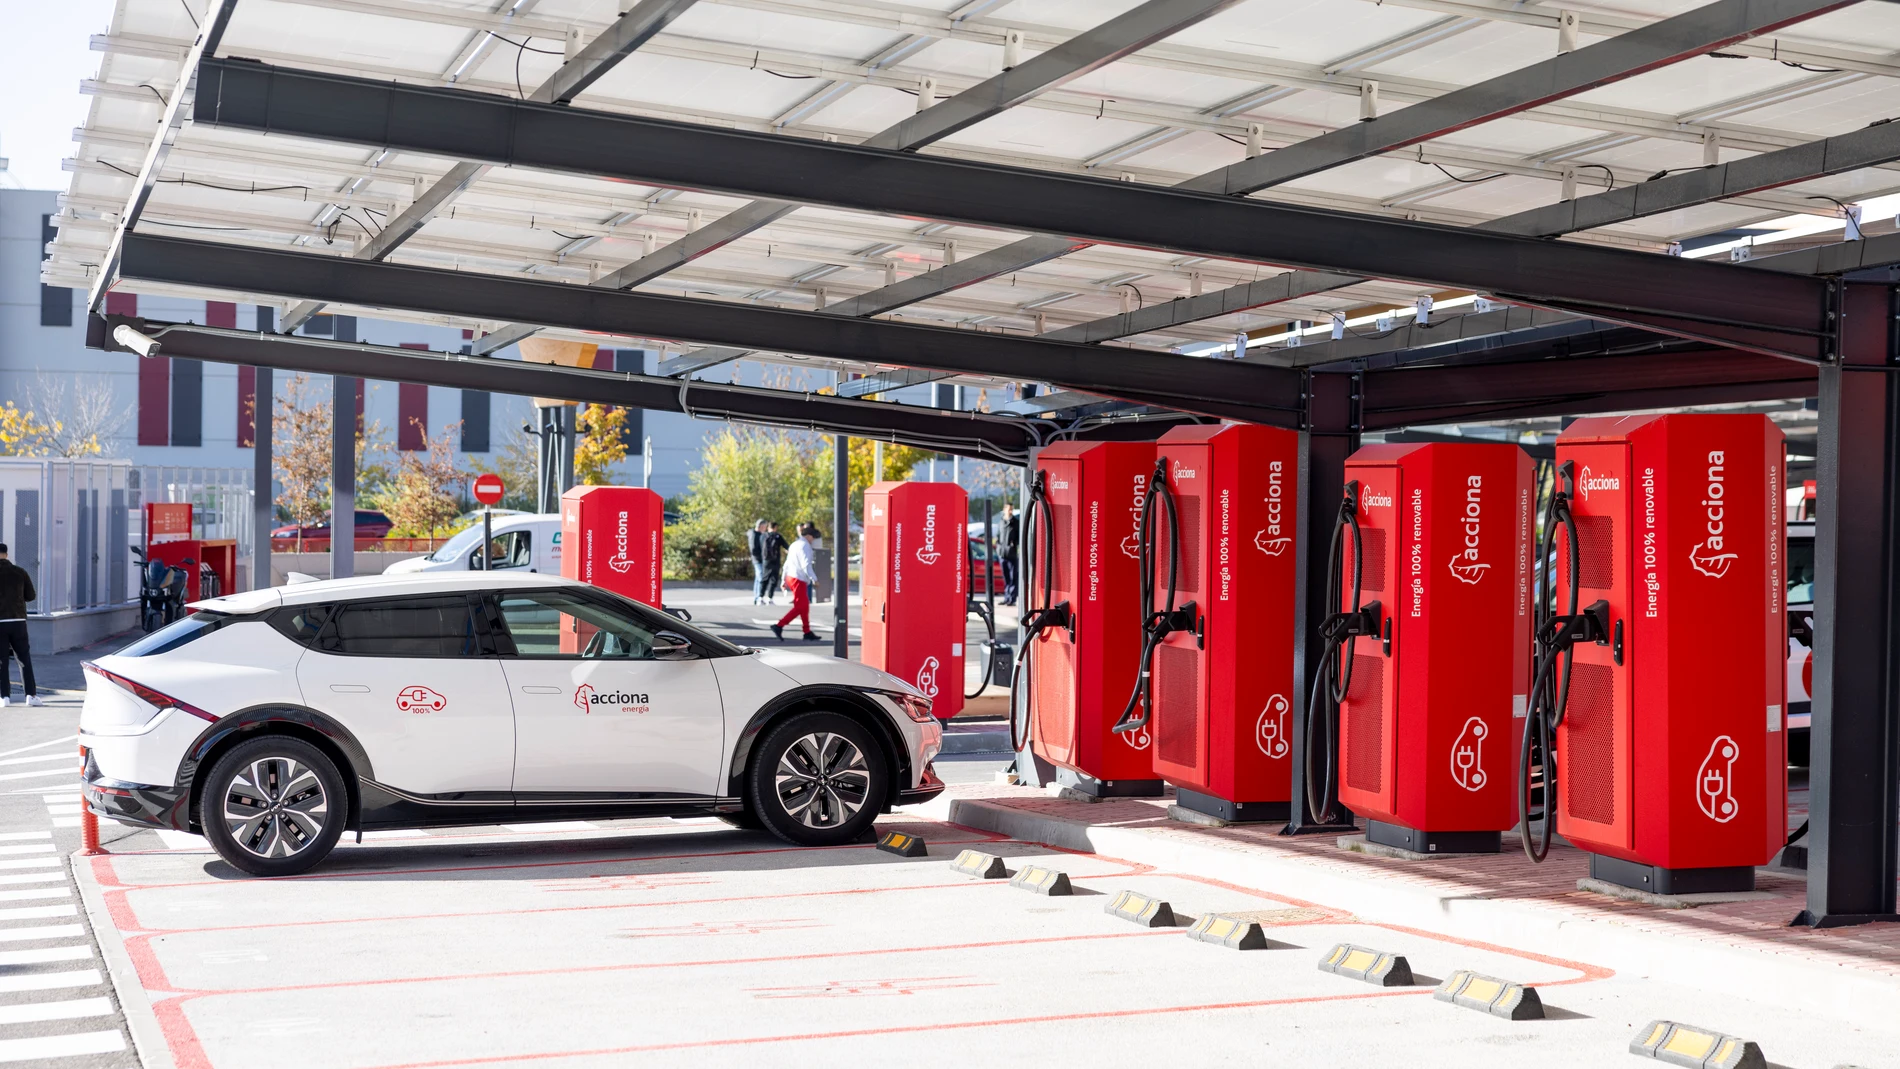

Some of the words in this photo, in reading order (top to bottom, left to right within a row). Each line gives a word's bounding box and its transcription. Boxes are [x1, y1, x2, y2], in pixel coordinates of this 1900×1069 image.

[1178, 466, 1195, 478] acciona
[1588, 474, 1620, 490] acciona
[1129, 475, 1145, 540] acciona
[1220, 489, 1229, 534] renovable
[1264, 461, 1282, 535] acciona
[1368, 493, 1392, 507] acciona
[1412, 489, 1422, 541] renovable
[1642, 468, 1655, 528] renovable
[1702, 450, 1724, 550] acciona
[616, 511, 628, 560] acciona
[923, 505, 936, 552] acciona
[1090, 501, 1098, 541] renovable
[1461, 475, 1481, 560] acciona
[1090, 543, 1098, 568] 100%
[1220, 537, 1228, 565] 100%
[1412, 544, 1421, 576] 100%
[1644, 532, 1656, 569] 100%
[894, 571, 902, 593] Energía
[1089, 570, 1099, 601] Energía
[1220, 567, 1231, 600] Energía
[1411, 578, 1424, 617] Energía
[1519, 578, 1527, 615] Energía
[1644, 572, 1660, 617] Energía
[1770, 568, 1778, 614] Energía
[591, 690, 649, 704] acciona
[622, 705, 649, 714] energía
